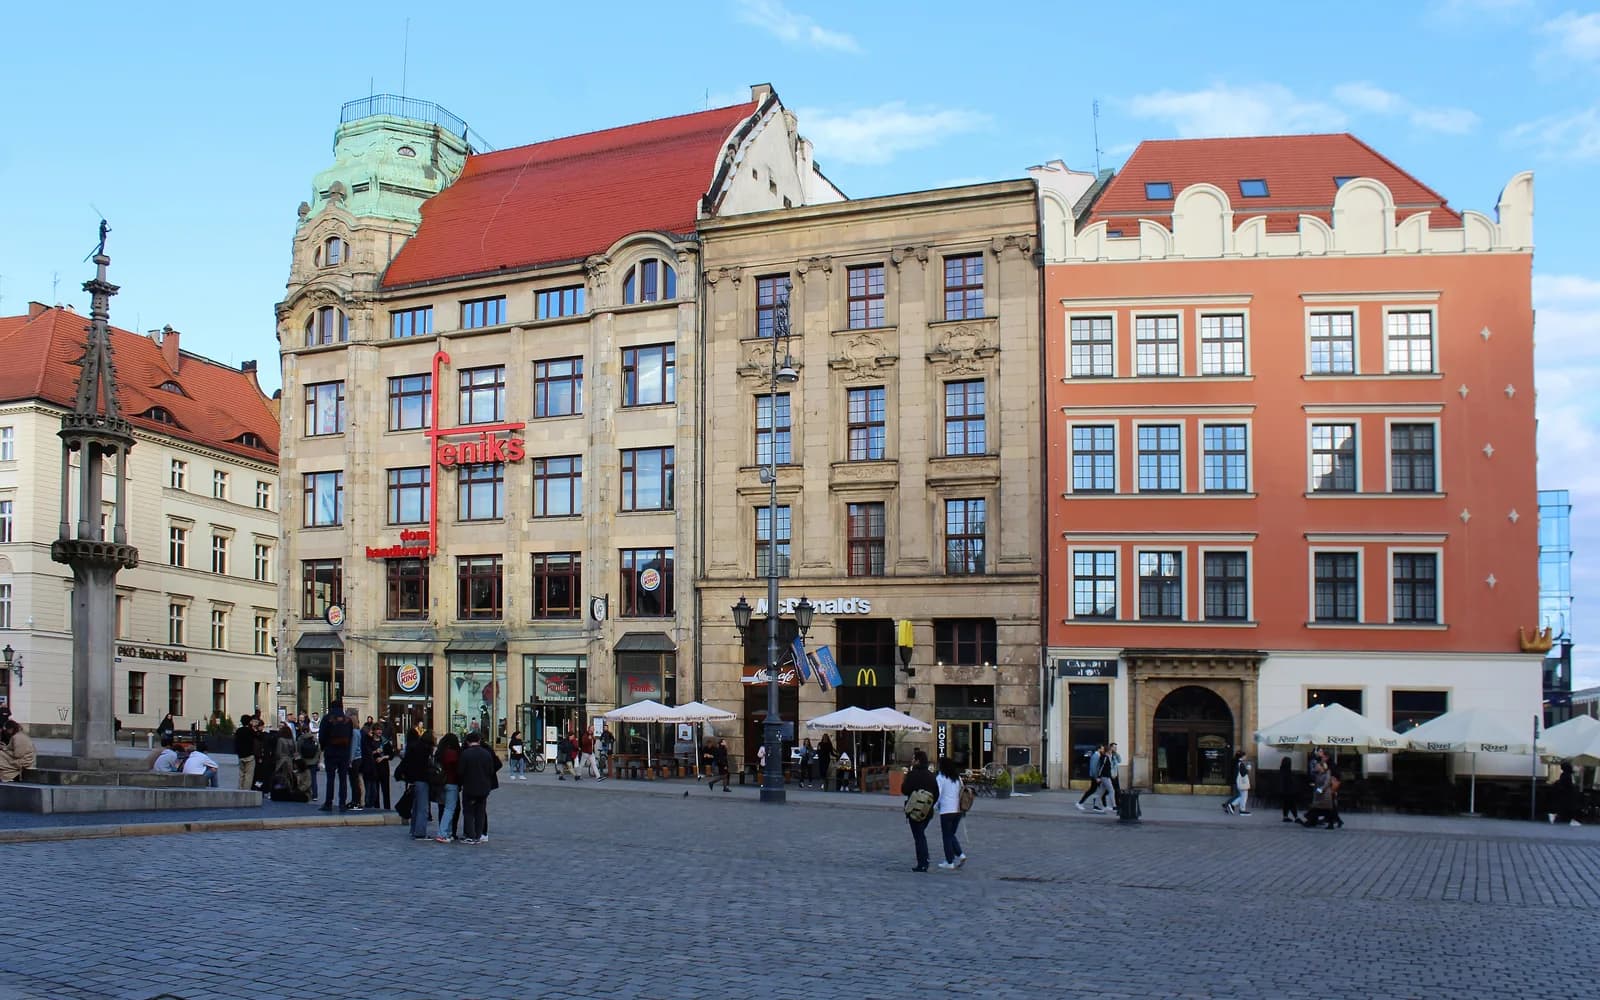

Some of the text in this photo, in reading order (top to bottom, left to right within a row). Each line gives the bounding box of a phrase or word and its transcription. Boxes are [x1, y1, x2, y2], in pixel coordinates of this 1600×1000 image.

[756, 597, 872, 614] McDnald's
[118, 646, 136, 657] PKO
[139, 648, 161, 660] Bank
[401, 673, 417, 683] KING
[938, 726, 946, 758] HOSTE
[1427, 742, 1508, 752] Kozel Kozel
